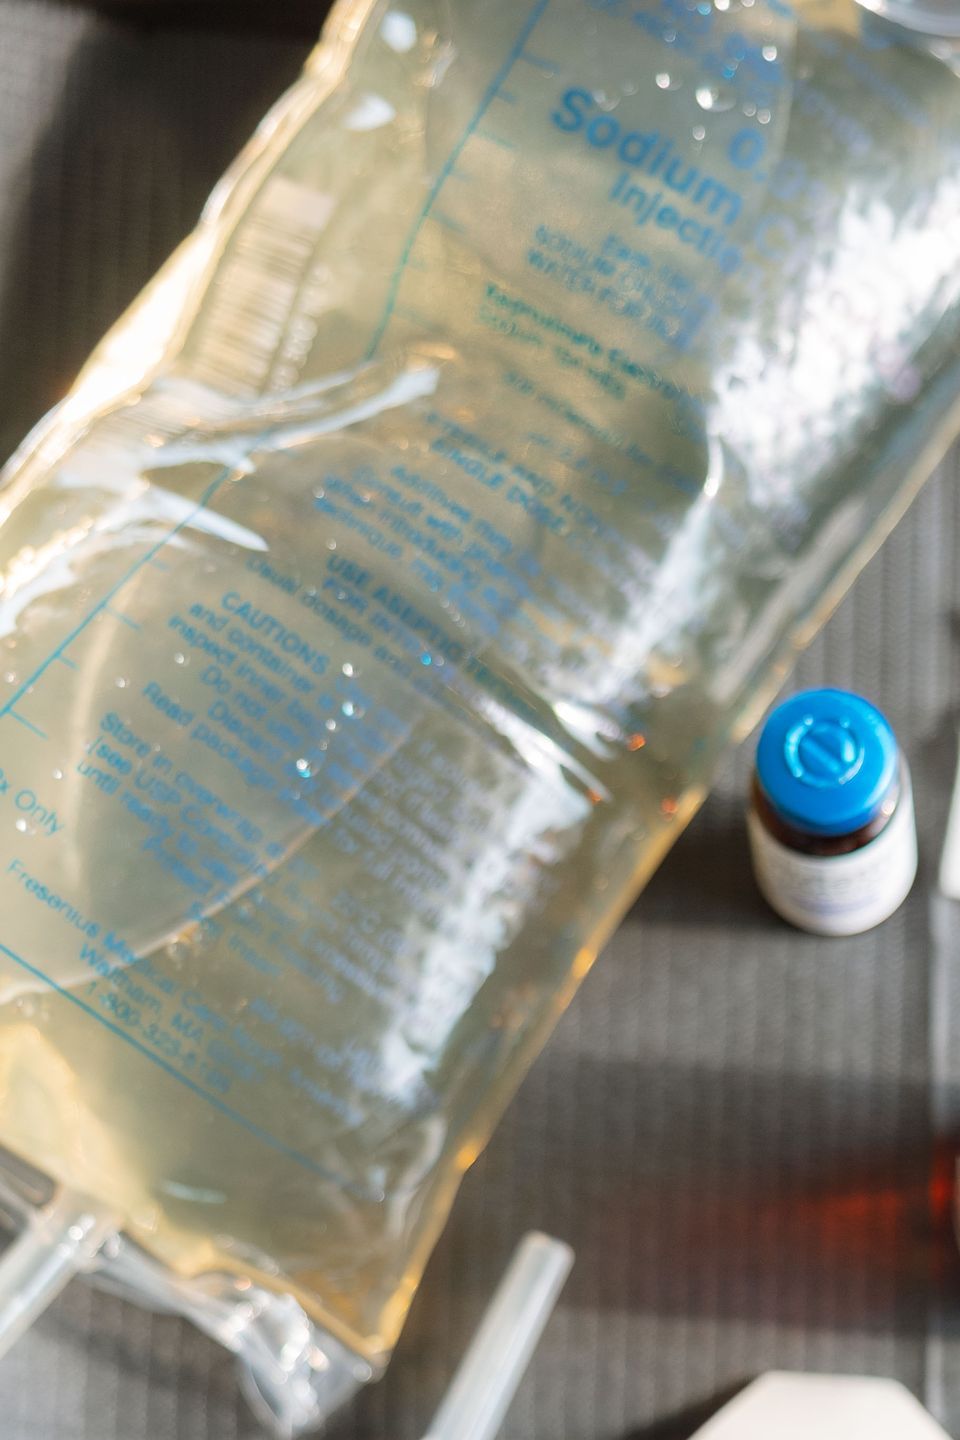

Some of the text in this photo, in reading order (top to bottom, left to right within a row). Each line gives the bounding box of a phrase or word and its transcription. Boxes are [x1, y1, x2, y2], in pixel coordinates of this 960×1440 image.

[549, 85, 744, 226] Sodium
[609, 171, 746, 276] Injectio
[188, 599, 228, 633] and
[224, 626, 319, 696] container
[215, 588, 335, 677] CAUTIONS
[140, 681, 197, 727] Read
[199, 663, 234, 695] Do
[98, 711, 155, 758] Store
[75, 757, 121, 795] until
[9, 786, 69, 837] Only
[6, 859, 102, 938] Fresenius
